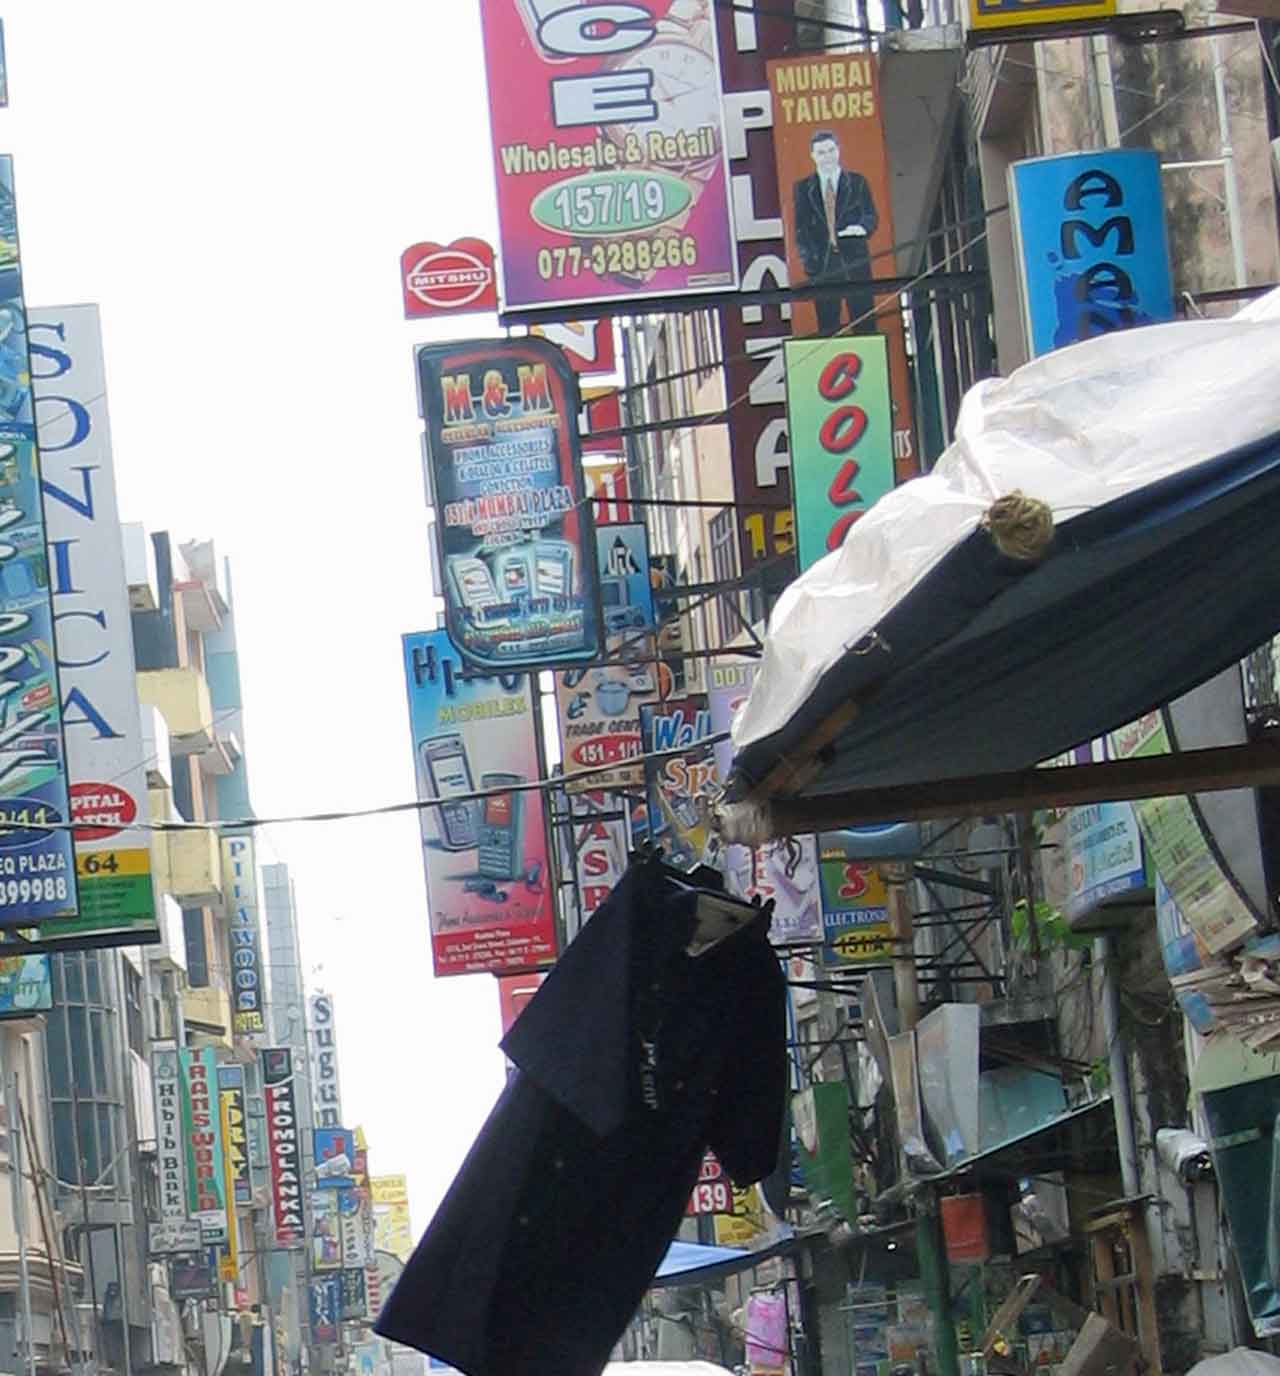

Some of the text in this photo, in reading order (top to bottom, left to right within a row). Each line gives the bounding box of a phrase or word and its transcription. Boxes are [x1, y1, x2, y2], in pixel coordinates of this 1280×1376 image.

[775, 61, 872, 94] MUMBAI
[781, 95, 874, 124] TAILORS
[501, 127, 716, 176] Wholesale & Retail
[554, 180, 665, 228] 157/19
[537, 236, 697, 280] 077-3288266
[441, 374, 474, 425] M
[517, 363, 553, 415] M
[19, 853, 67, 873] PLAZA
[76, 852, 119, 875] 64
[158, 1083, 176, 1149] Habib
[163, 1157, 180, 1206] Bank
